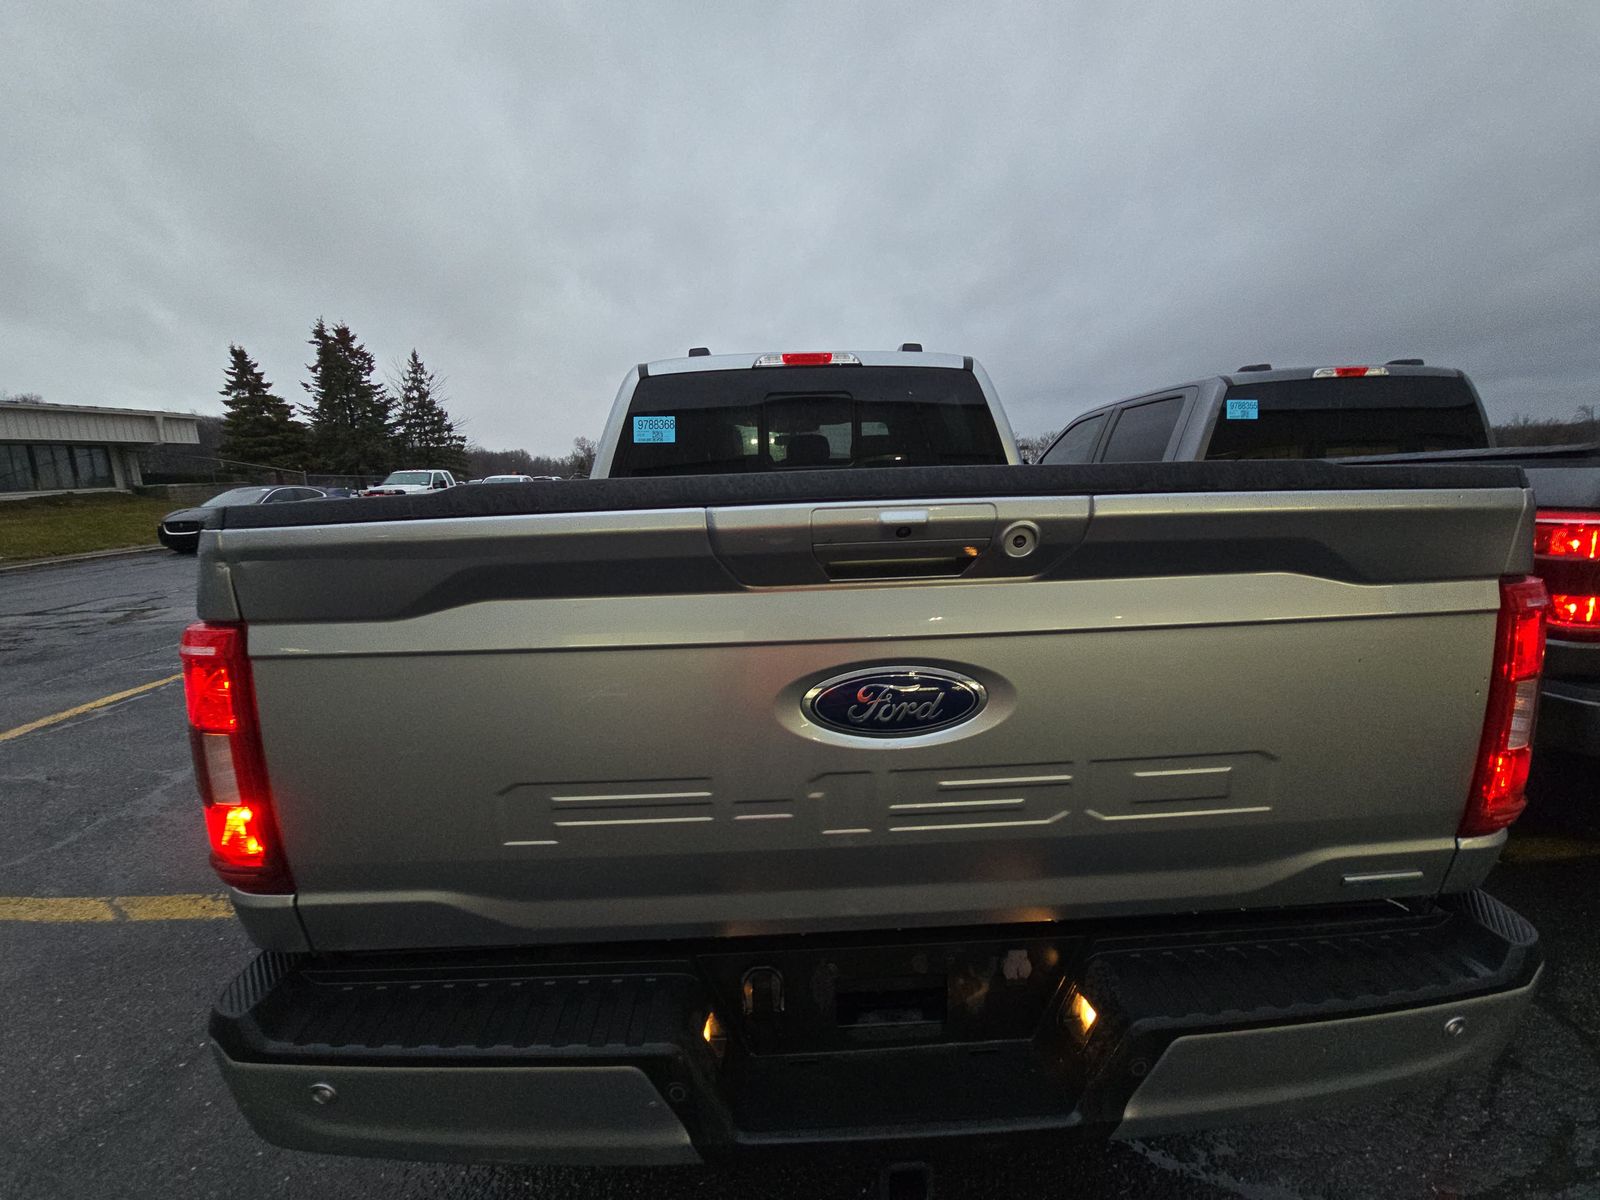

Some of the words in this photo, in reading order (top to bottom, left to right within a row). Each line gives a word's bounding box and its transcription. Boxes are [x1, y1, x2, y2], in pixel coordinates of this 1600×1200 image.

[637, 419, 675, 430] 9788368
[847, 683, 945, 723] Ford
[496, 750, 1279, 848] F-150
